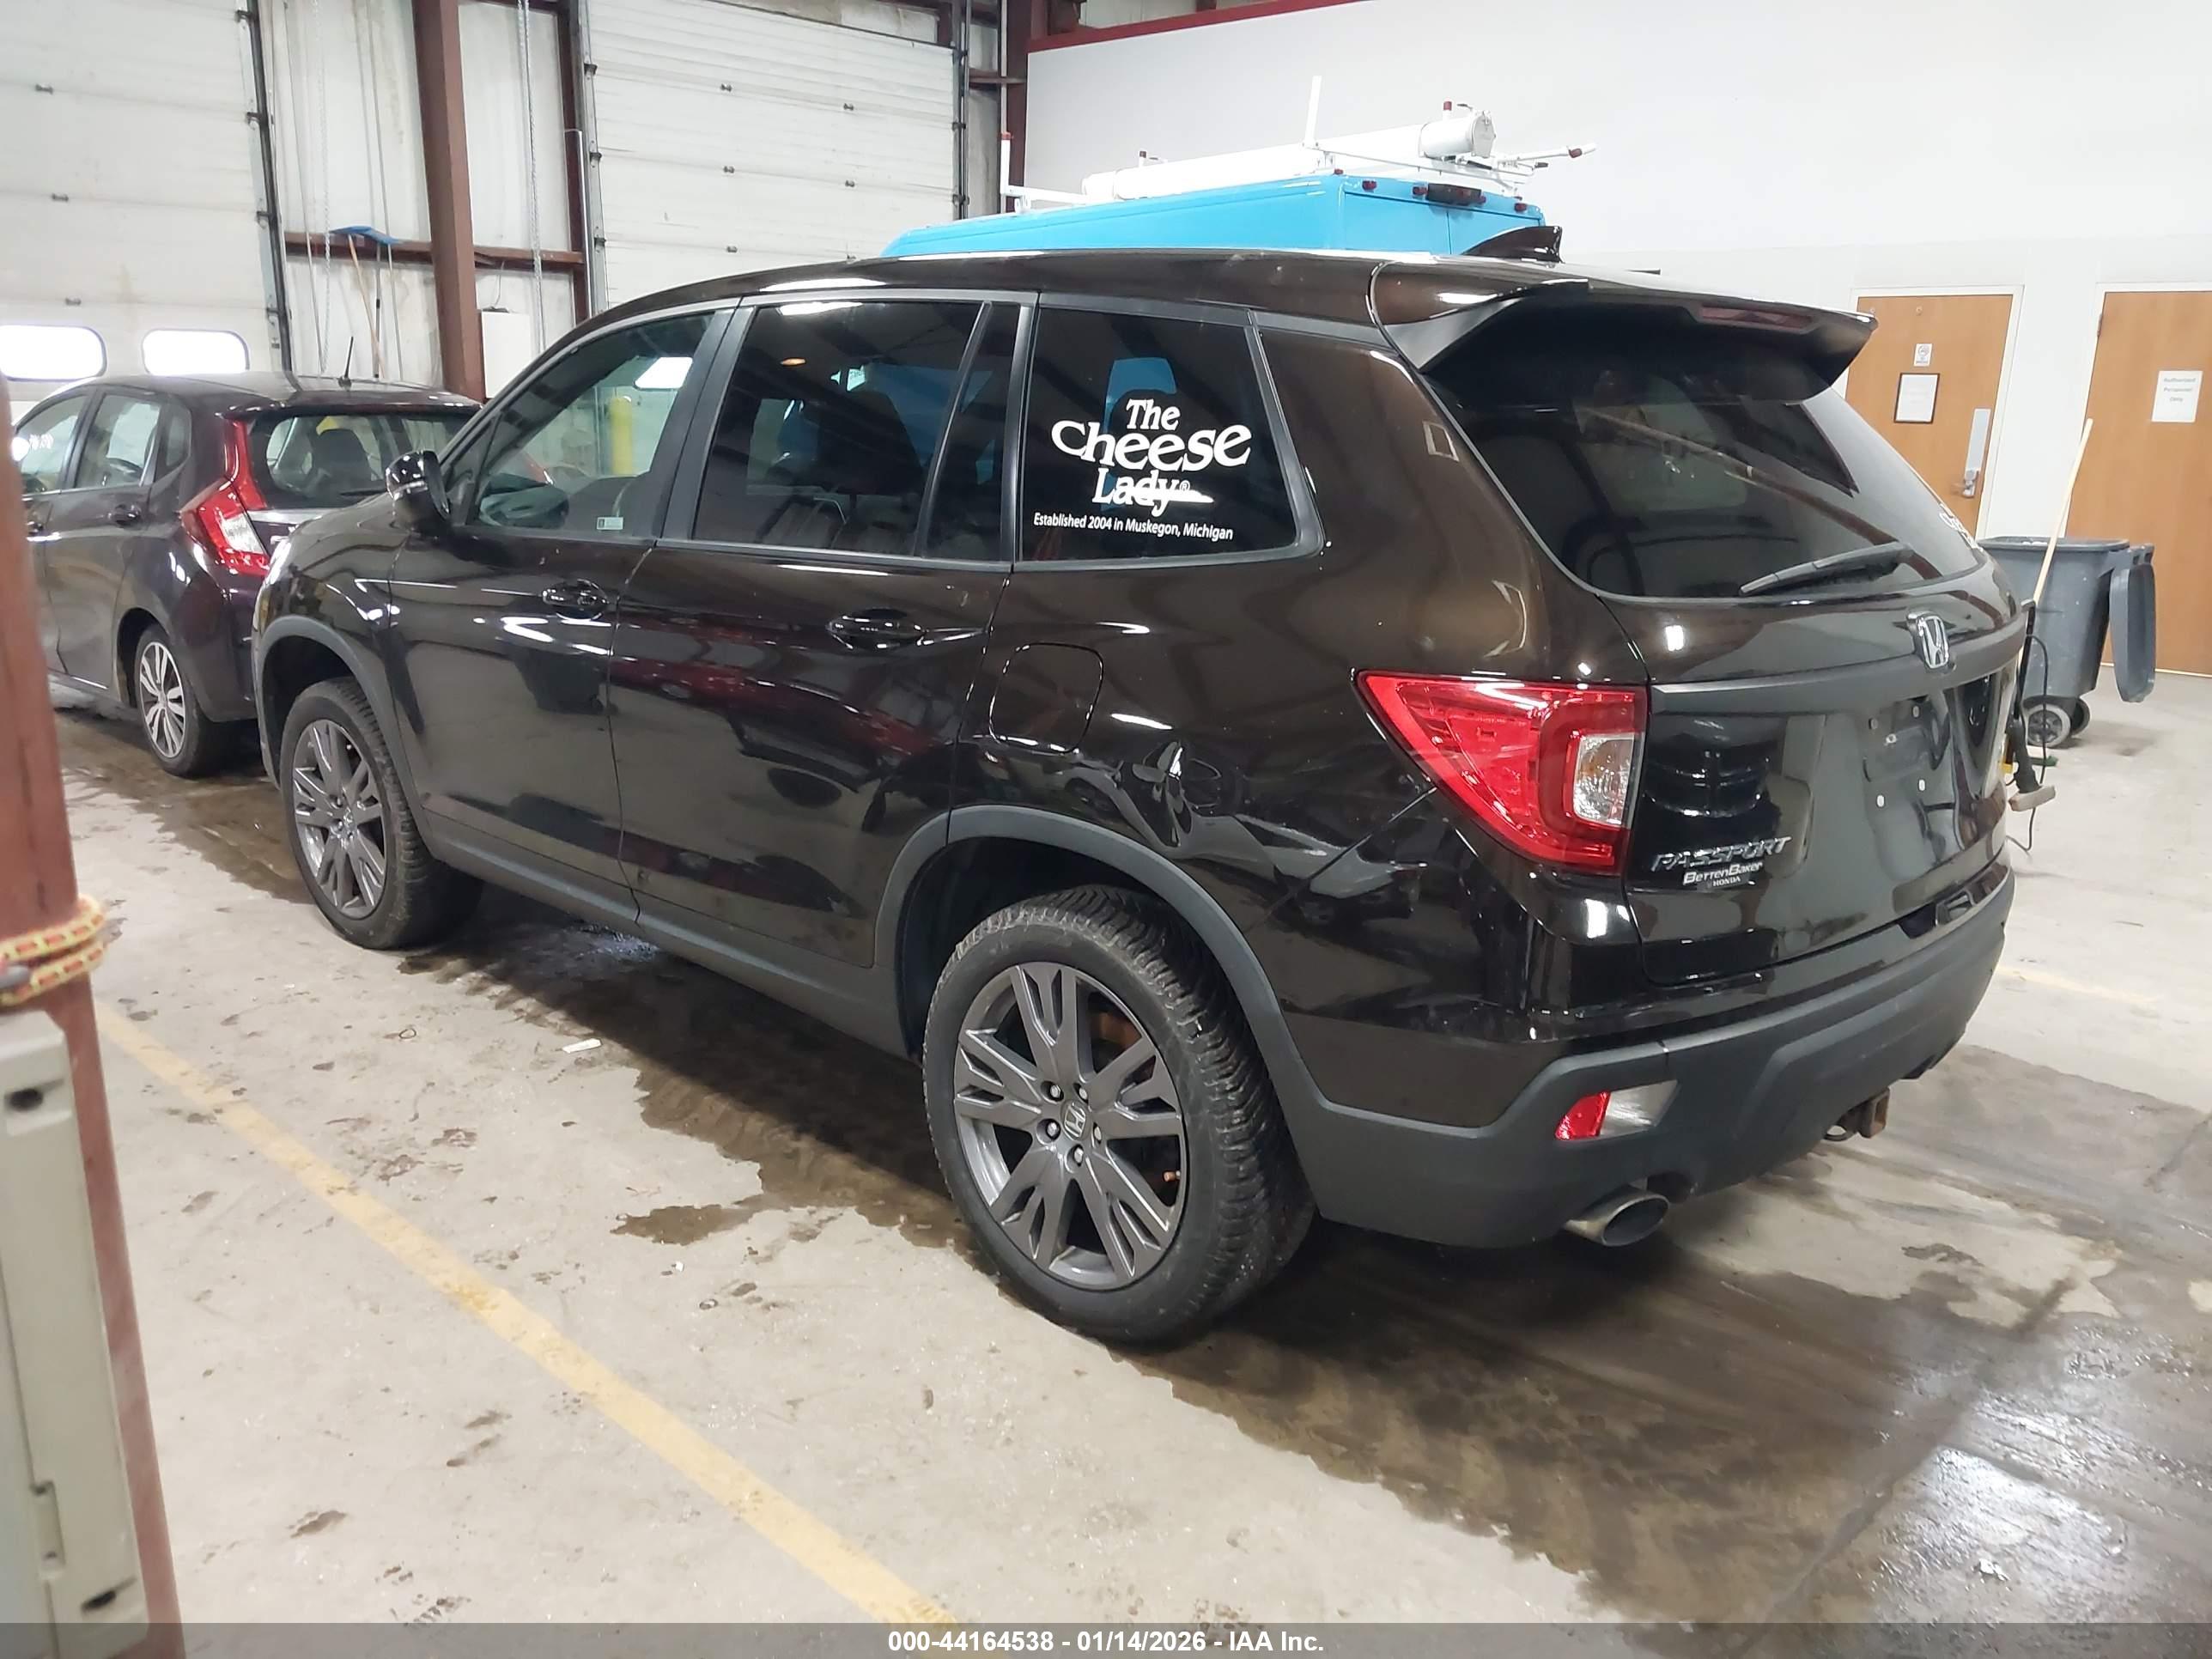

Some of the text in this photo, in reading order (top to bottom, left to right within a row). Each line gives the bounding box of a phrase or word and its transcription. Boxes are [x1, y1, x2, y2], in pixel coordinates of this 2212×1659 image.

[1126, 398, 1181, 430] The
[1051, 420, 1252, 471] Cheese
[1033, 512, 1234, 542] Established 2004 in Muskegon, Michigan
[1650, 836, 1792, 872] PASSPORT
[1712, 875, 1741, 887] HONDA
